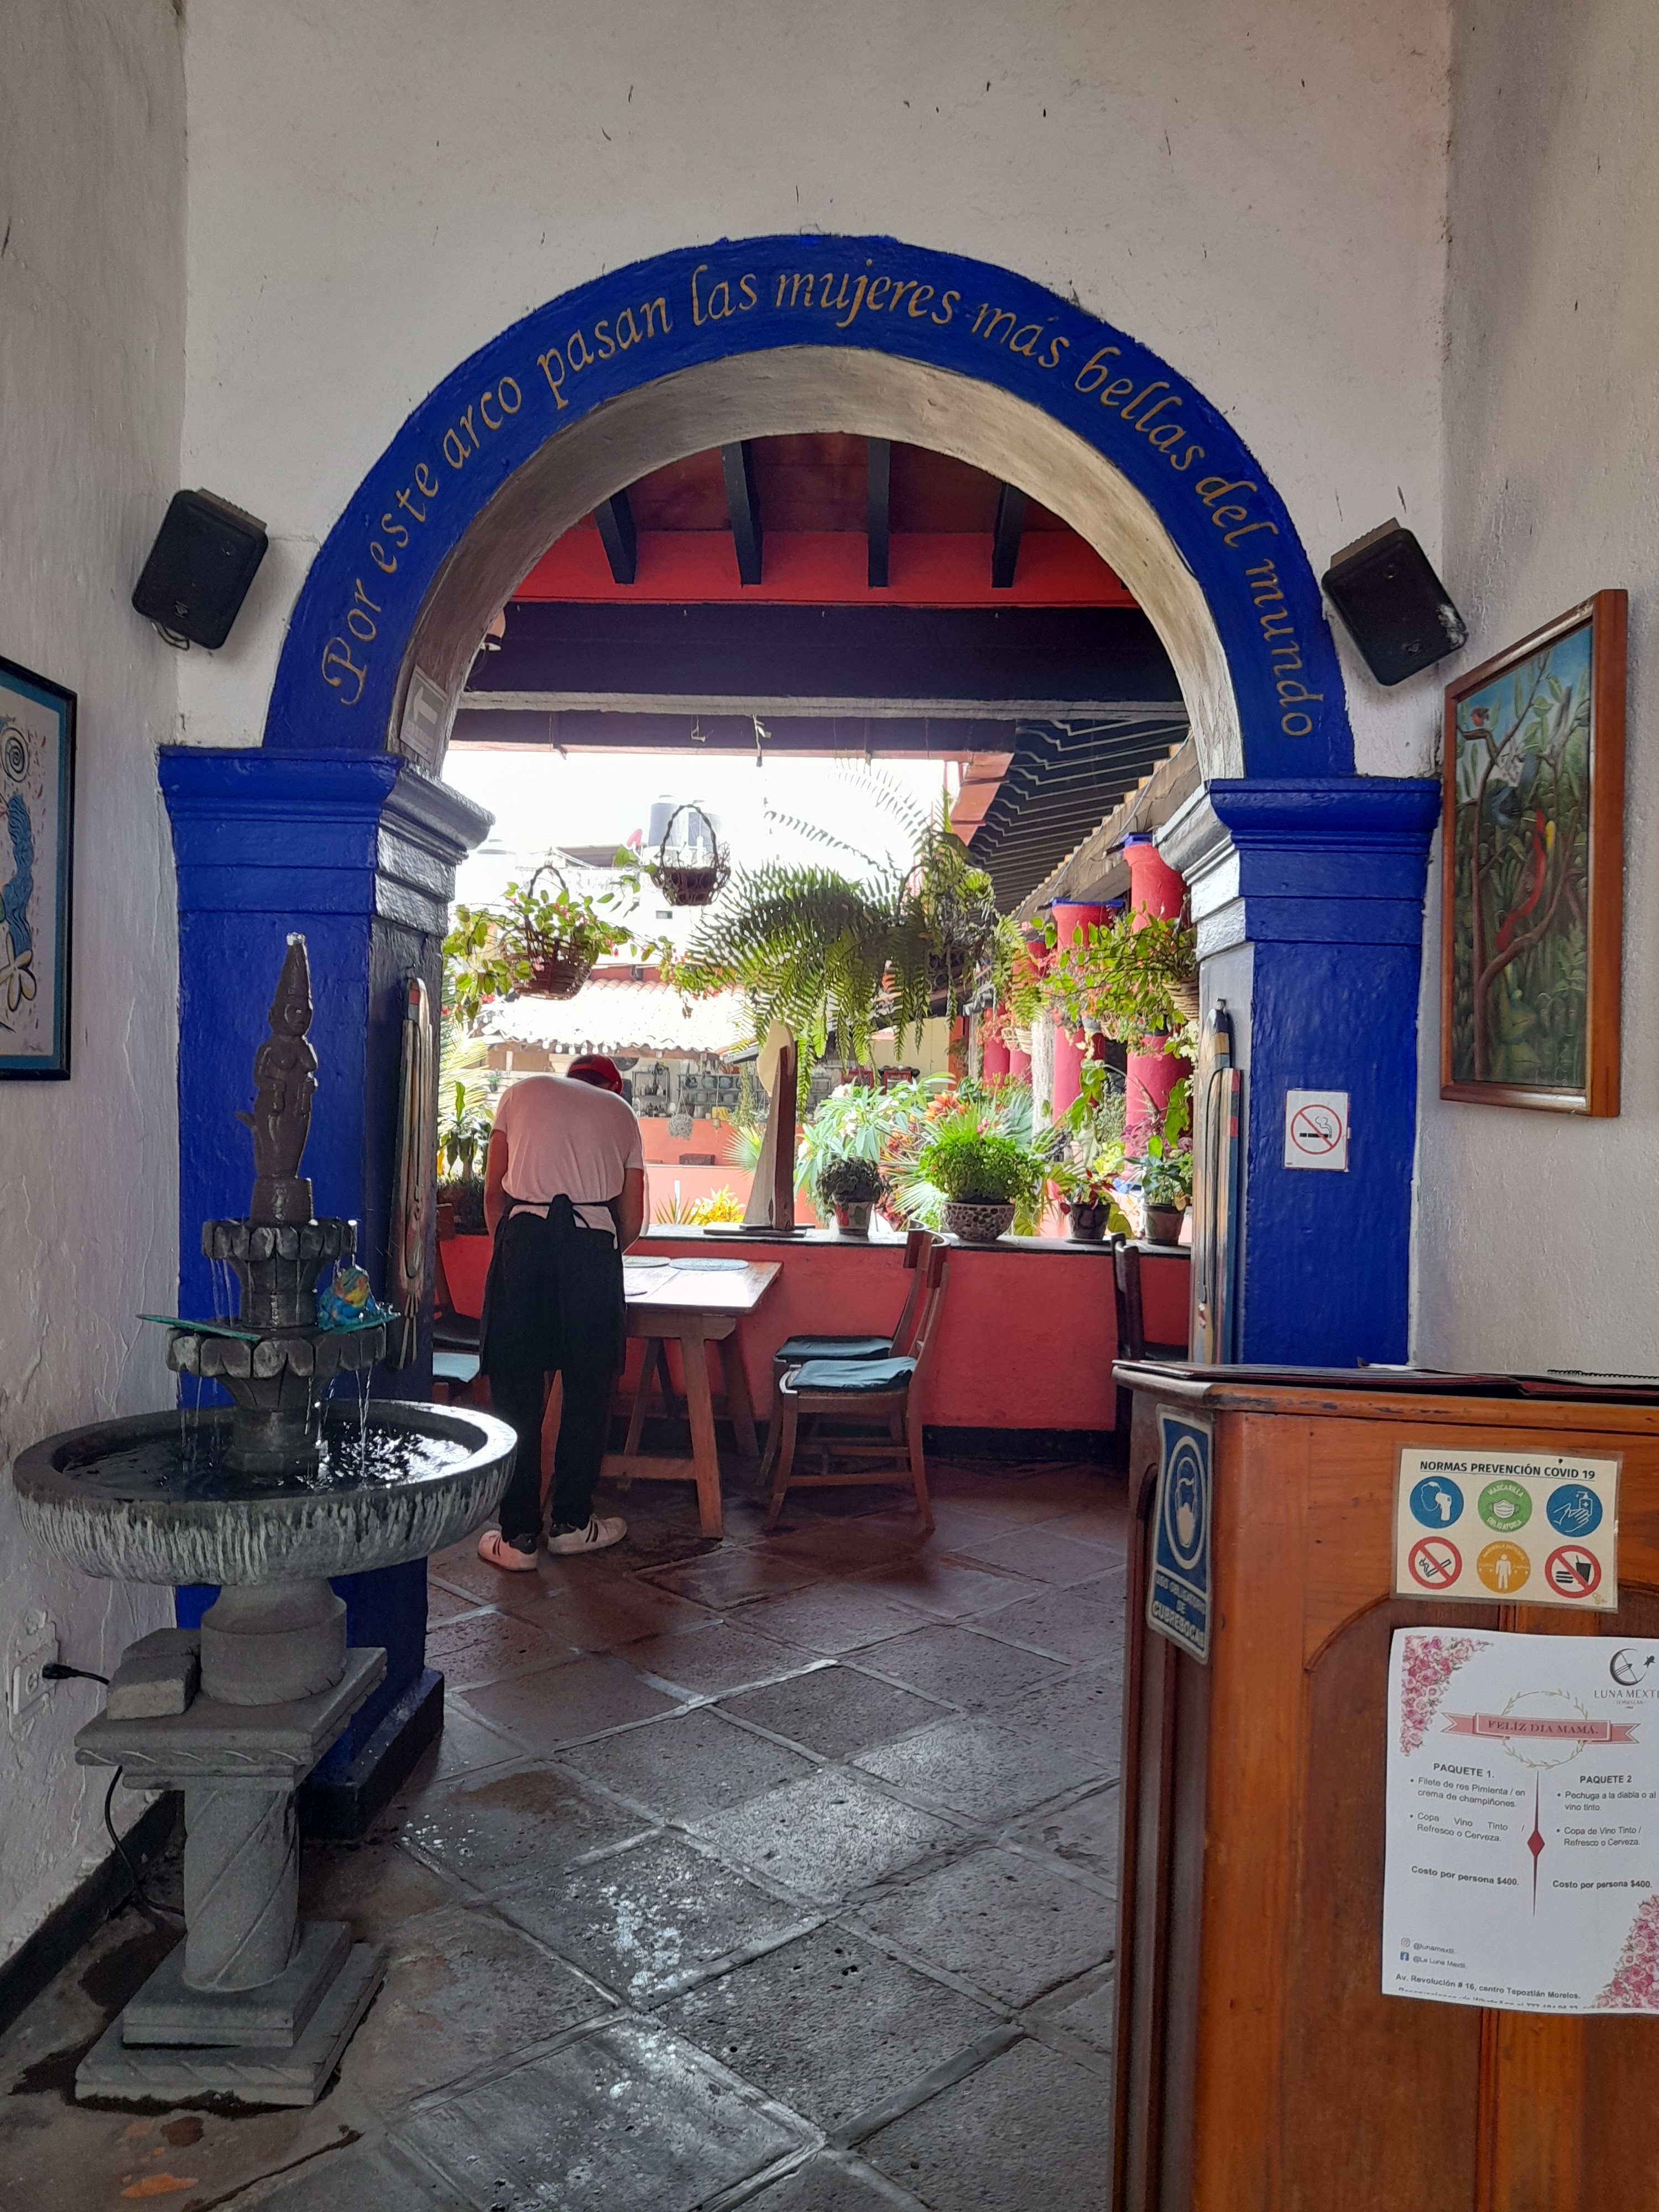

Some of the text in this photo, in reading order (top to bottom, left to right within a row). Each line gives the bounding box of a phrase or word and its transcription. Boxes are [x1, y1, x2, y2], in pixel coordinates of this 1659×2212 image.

[321, 260, 1324, 737] Por este arco pasan las mujeres más bellas del mundo
[1420, 1460, 1595, 1479] NORMAS PREVENCIÓN COVID 19
[1176, 1599, 1186, 1615] DE
[1152, 1600, 1204, 1647] CUBREBOCAS
[1594, 1689, 1623, 1698] LUNA
[1488, 1719, 1527, 1731] FELÍZ
[1531, 1723, 1553, 1733] DIA
[1433, 1763, 1483, 1777] PAQUETE
[1418, 1777, 1441, 1786] Filete
[1472, 1784, 1508, 1796] Pimienta
[1580, 1775, 1624, 1784] PAQUETE
[1418, 1790, 1443, 1798] crema
[1565, 1791, 1599, 1801] Pechuga
[1417, 1812, 1439, 1823] Copa
[1454, 1817, 1473, 1827] Vino
[1488, 1822, 1508, 1831] Tinto
[1417, 1824, 1454, 1837] Refresco
[1465, 1831, 1502, 1841] Cerveza.
[1564, 1827, 1585, 1835] Copa
[1564, 1838, 1599, 1846] Refresco
[1411, 1866, 1438, 1876] Costo
[1458, 1874, 1494, 1884] persona
[1597, 1881, 1628, 1890] persona
[1395, 1973, 1408, 1981] Av.
[1411, 1975, 1455, 1987] Revolución
[1479, 1985, 1504, 1994] centro
[1506, 1987, 1545, 1997] Tepoztlán
[1548, 1991, 1580, 1999] Morelos.
